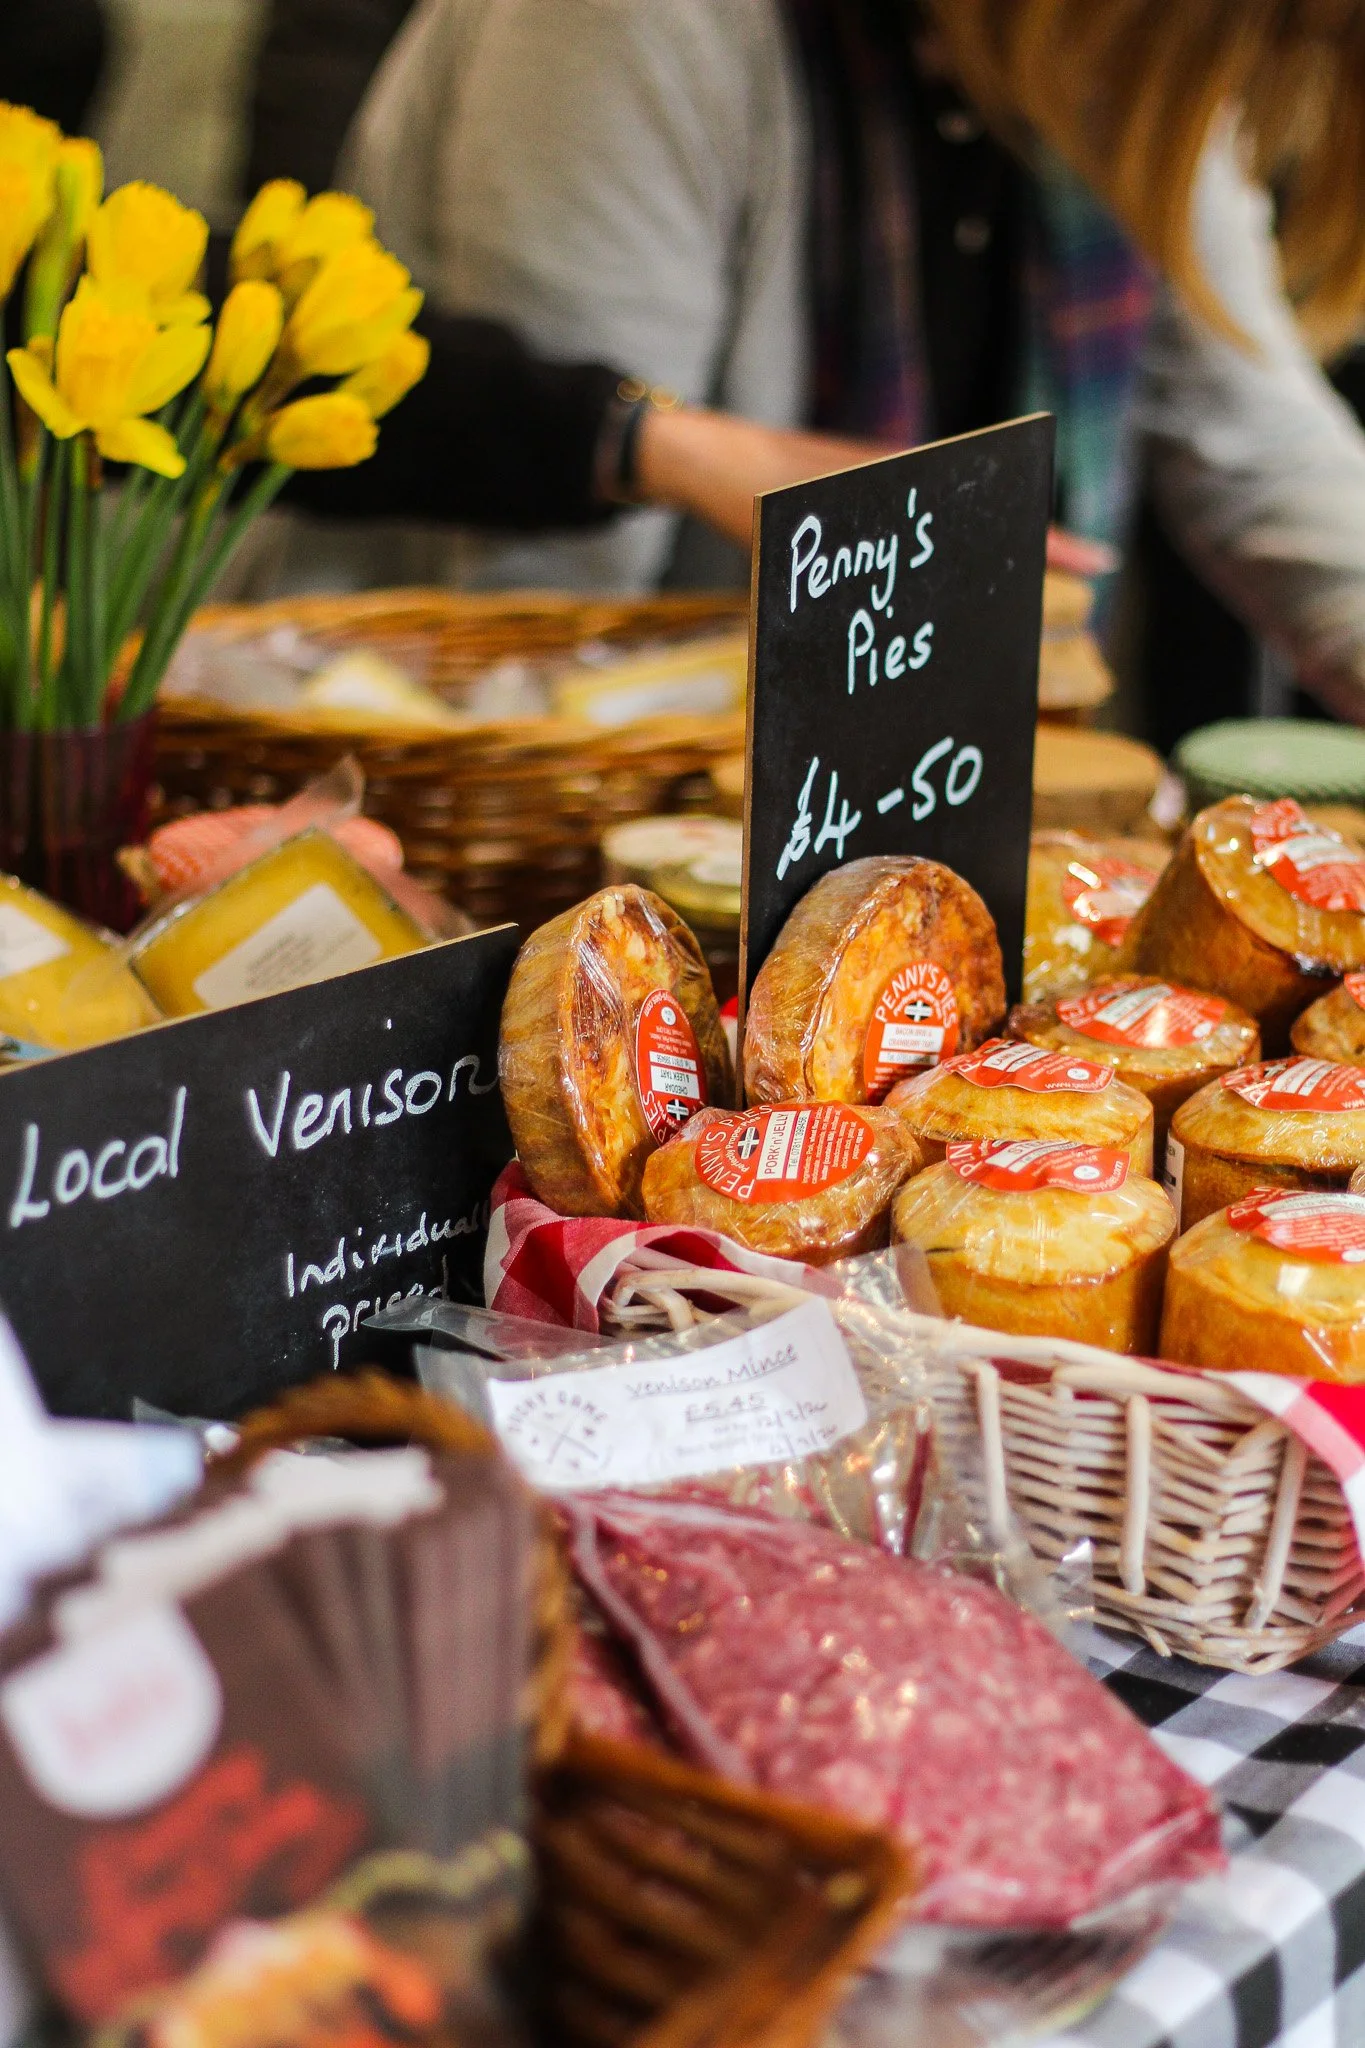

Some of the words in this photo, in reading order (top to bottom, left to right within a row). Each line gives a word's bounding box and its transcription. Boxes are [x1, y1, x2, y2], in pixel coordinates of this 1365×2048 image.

[790, 488, 935, 613] Penny's
[847, 604, 935, 695] Pies
[875, 963, 940, 1022] PENNY'S
[936, 977, 958, 1029] PIES
[664, 1082, 688, 1096] CHEDDAR
[719, 1105, 772, 1127] PIES
[9, 1085, 187, 1228] Local
[247, 1018, 500, 1158] Venison
[726, 1126, 743, 1149] Proper
[741, 1116, 761, 1127] Pies
[701, 1131, 755, 1199] PENNY'S
[625, 1373, 720, 1397] Venison
[727, 1343, 799, 1382] Mince
